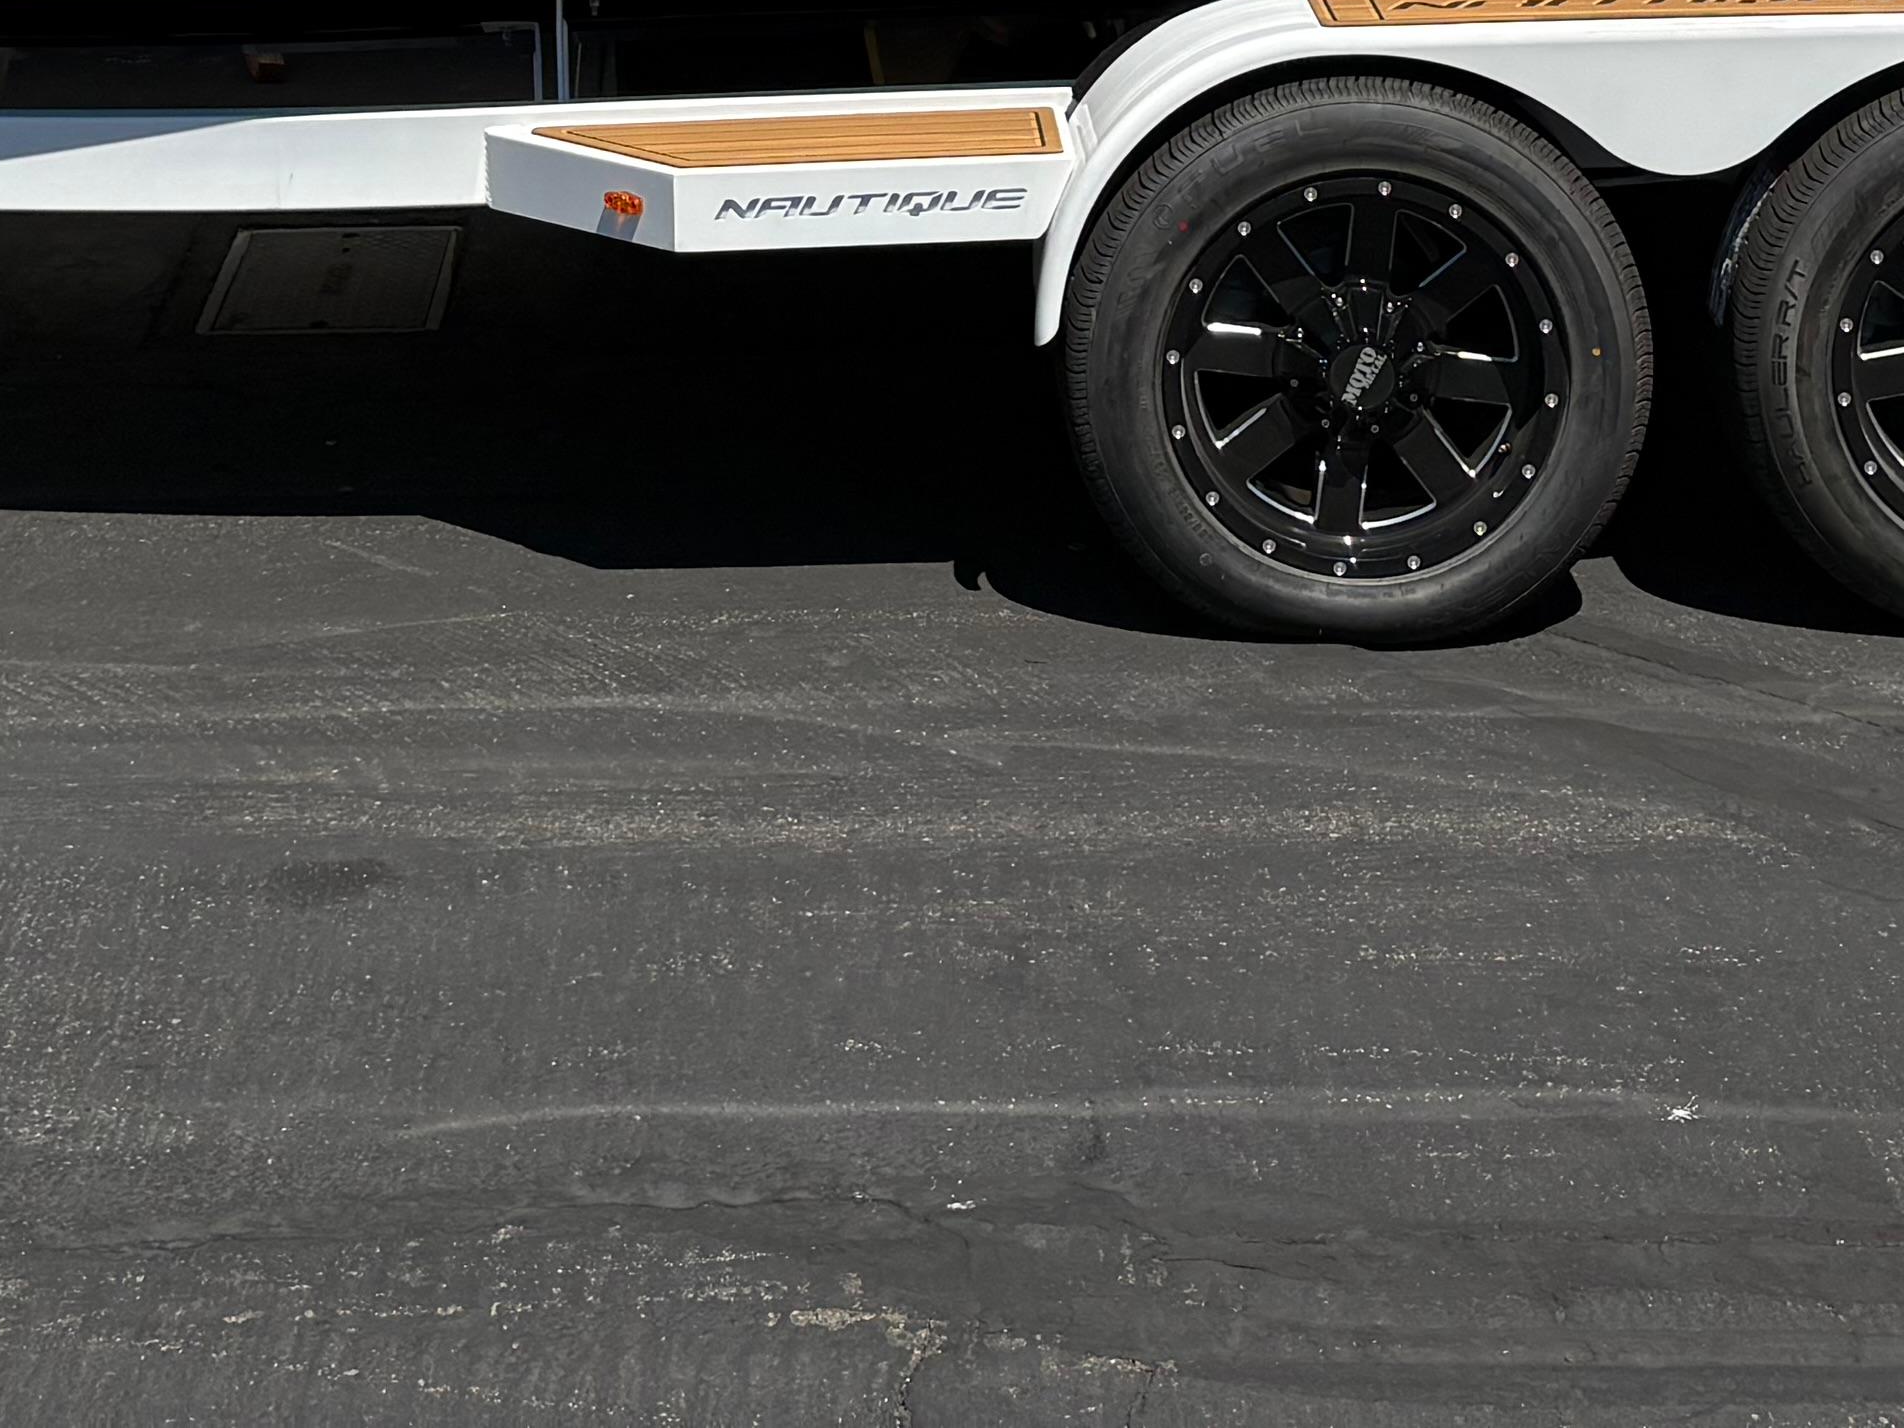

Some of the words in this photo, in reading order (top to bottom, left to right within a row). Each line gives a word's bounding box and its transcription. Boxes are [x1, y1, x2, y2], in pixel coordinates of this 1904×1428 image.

[714, 187, 1028, 221] NAUTIQUE
[1776, 257, 1807, 327] R/T
[1340, 347, 1377, 406] MOTO
[1770, 332, 1812, 485] HAULER
